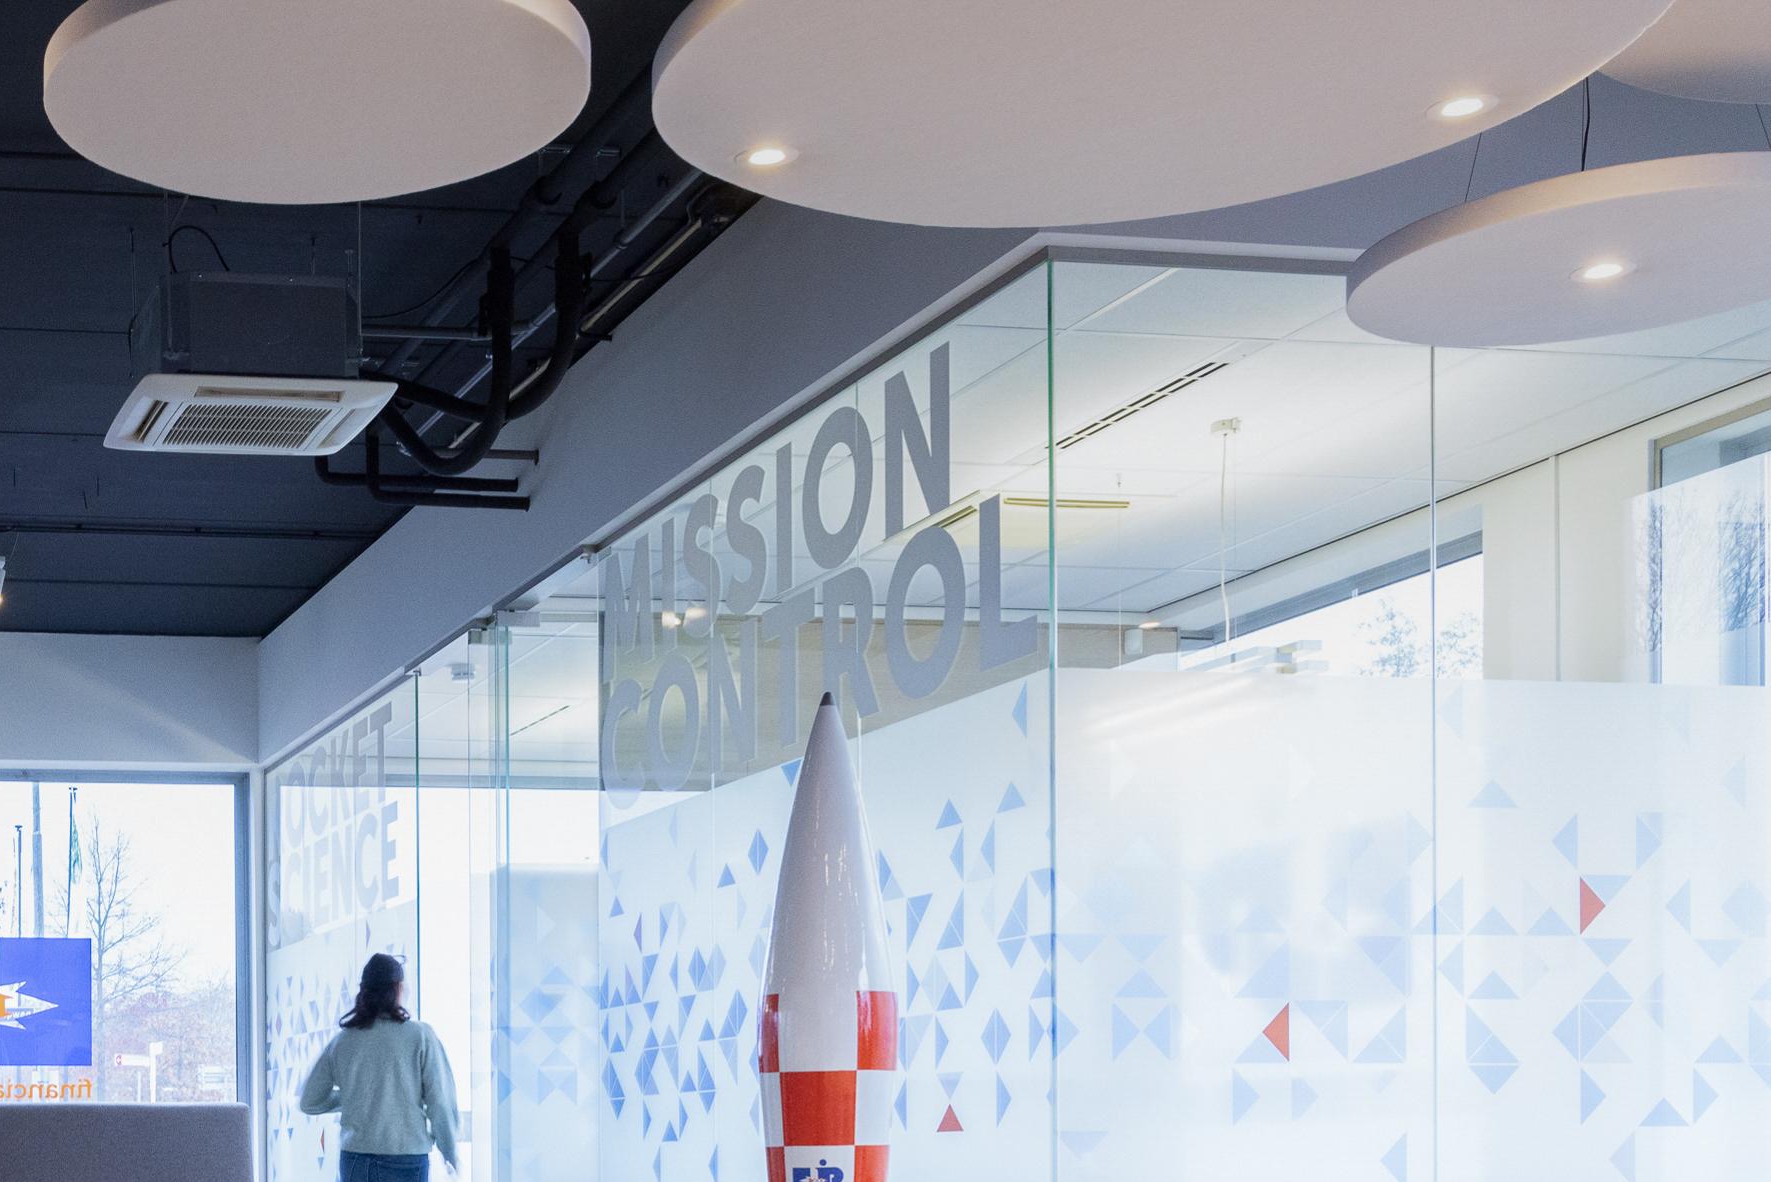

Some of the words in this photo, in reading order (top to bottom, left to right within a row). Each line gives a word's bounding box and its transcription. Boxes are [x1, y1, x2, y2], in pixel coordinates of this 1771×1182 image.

[602, 494, 1038, 810] CONTROL
[603, 341, 950, 684] MISSION
[268, 800, 400, 947] SCIENCE
